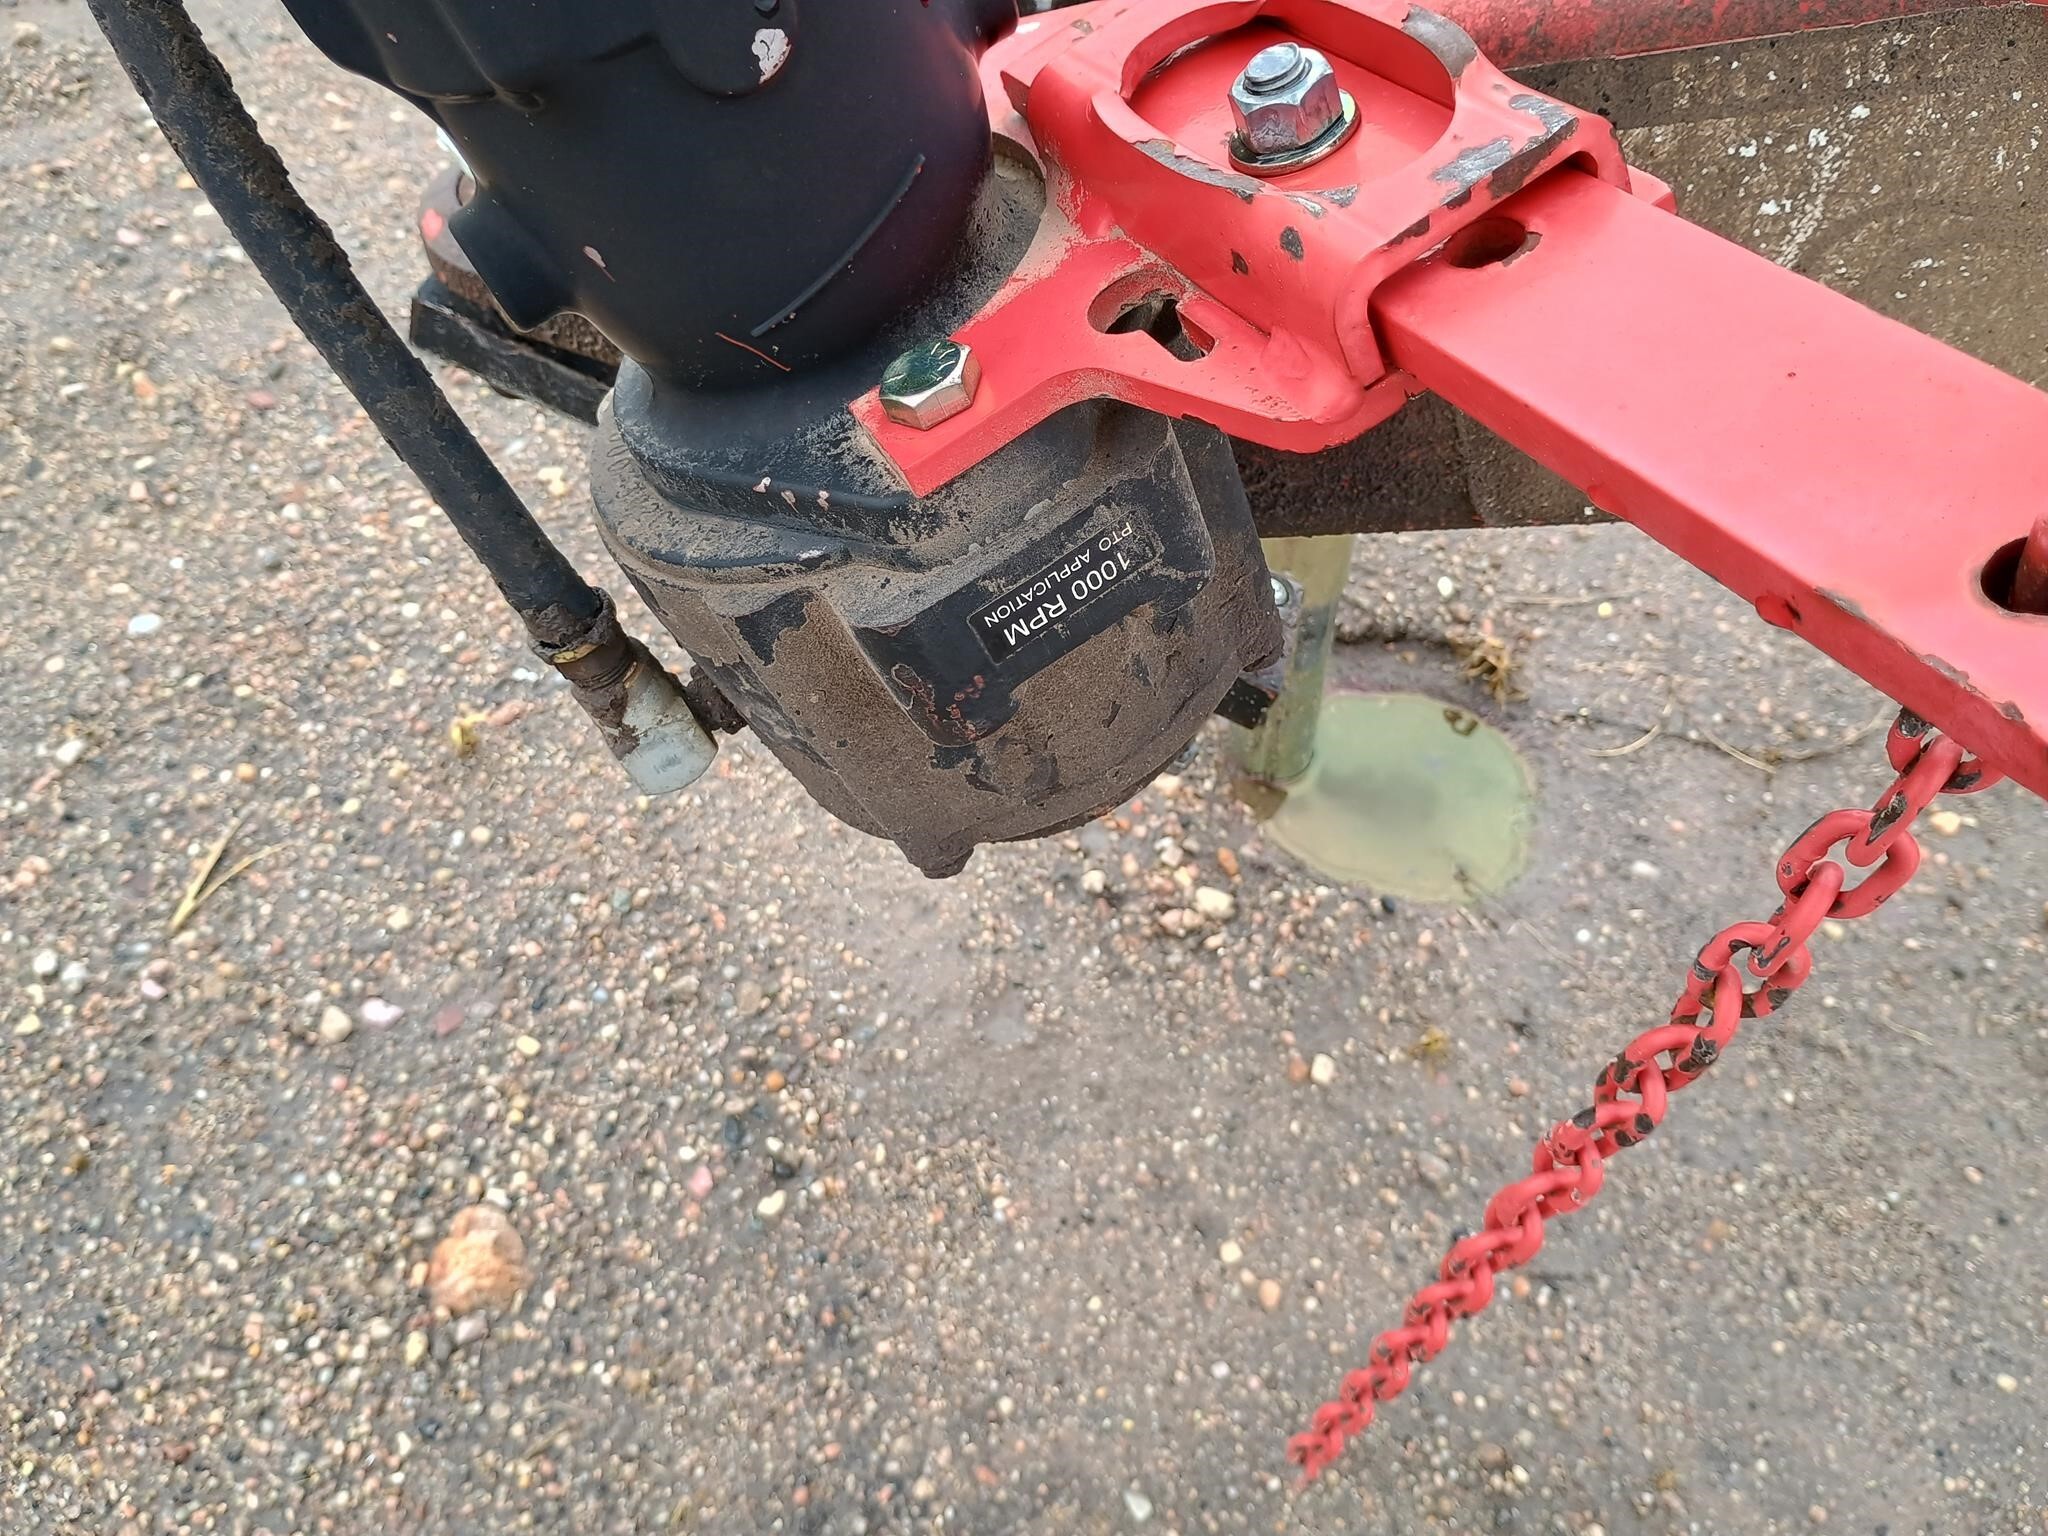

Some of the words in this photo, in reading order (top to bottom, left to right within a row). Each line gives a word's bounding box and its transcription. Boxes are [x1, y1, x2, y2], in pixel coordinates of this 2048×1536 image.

[1099, 522, 1132, 551] PTO
[984, 549, 1091, 628] APPLICATION
[1071, 552, 1131, 601] 1000
[1003, 594, 1068, 646] RPM
